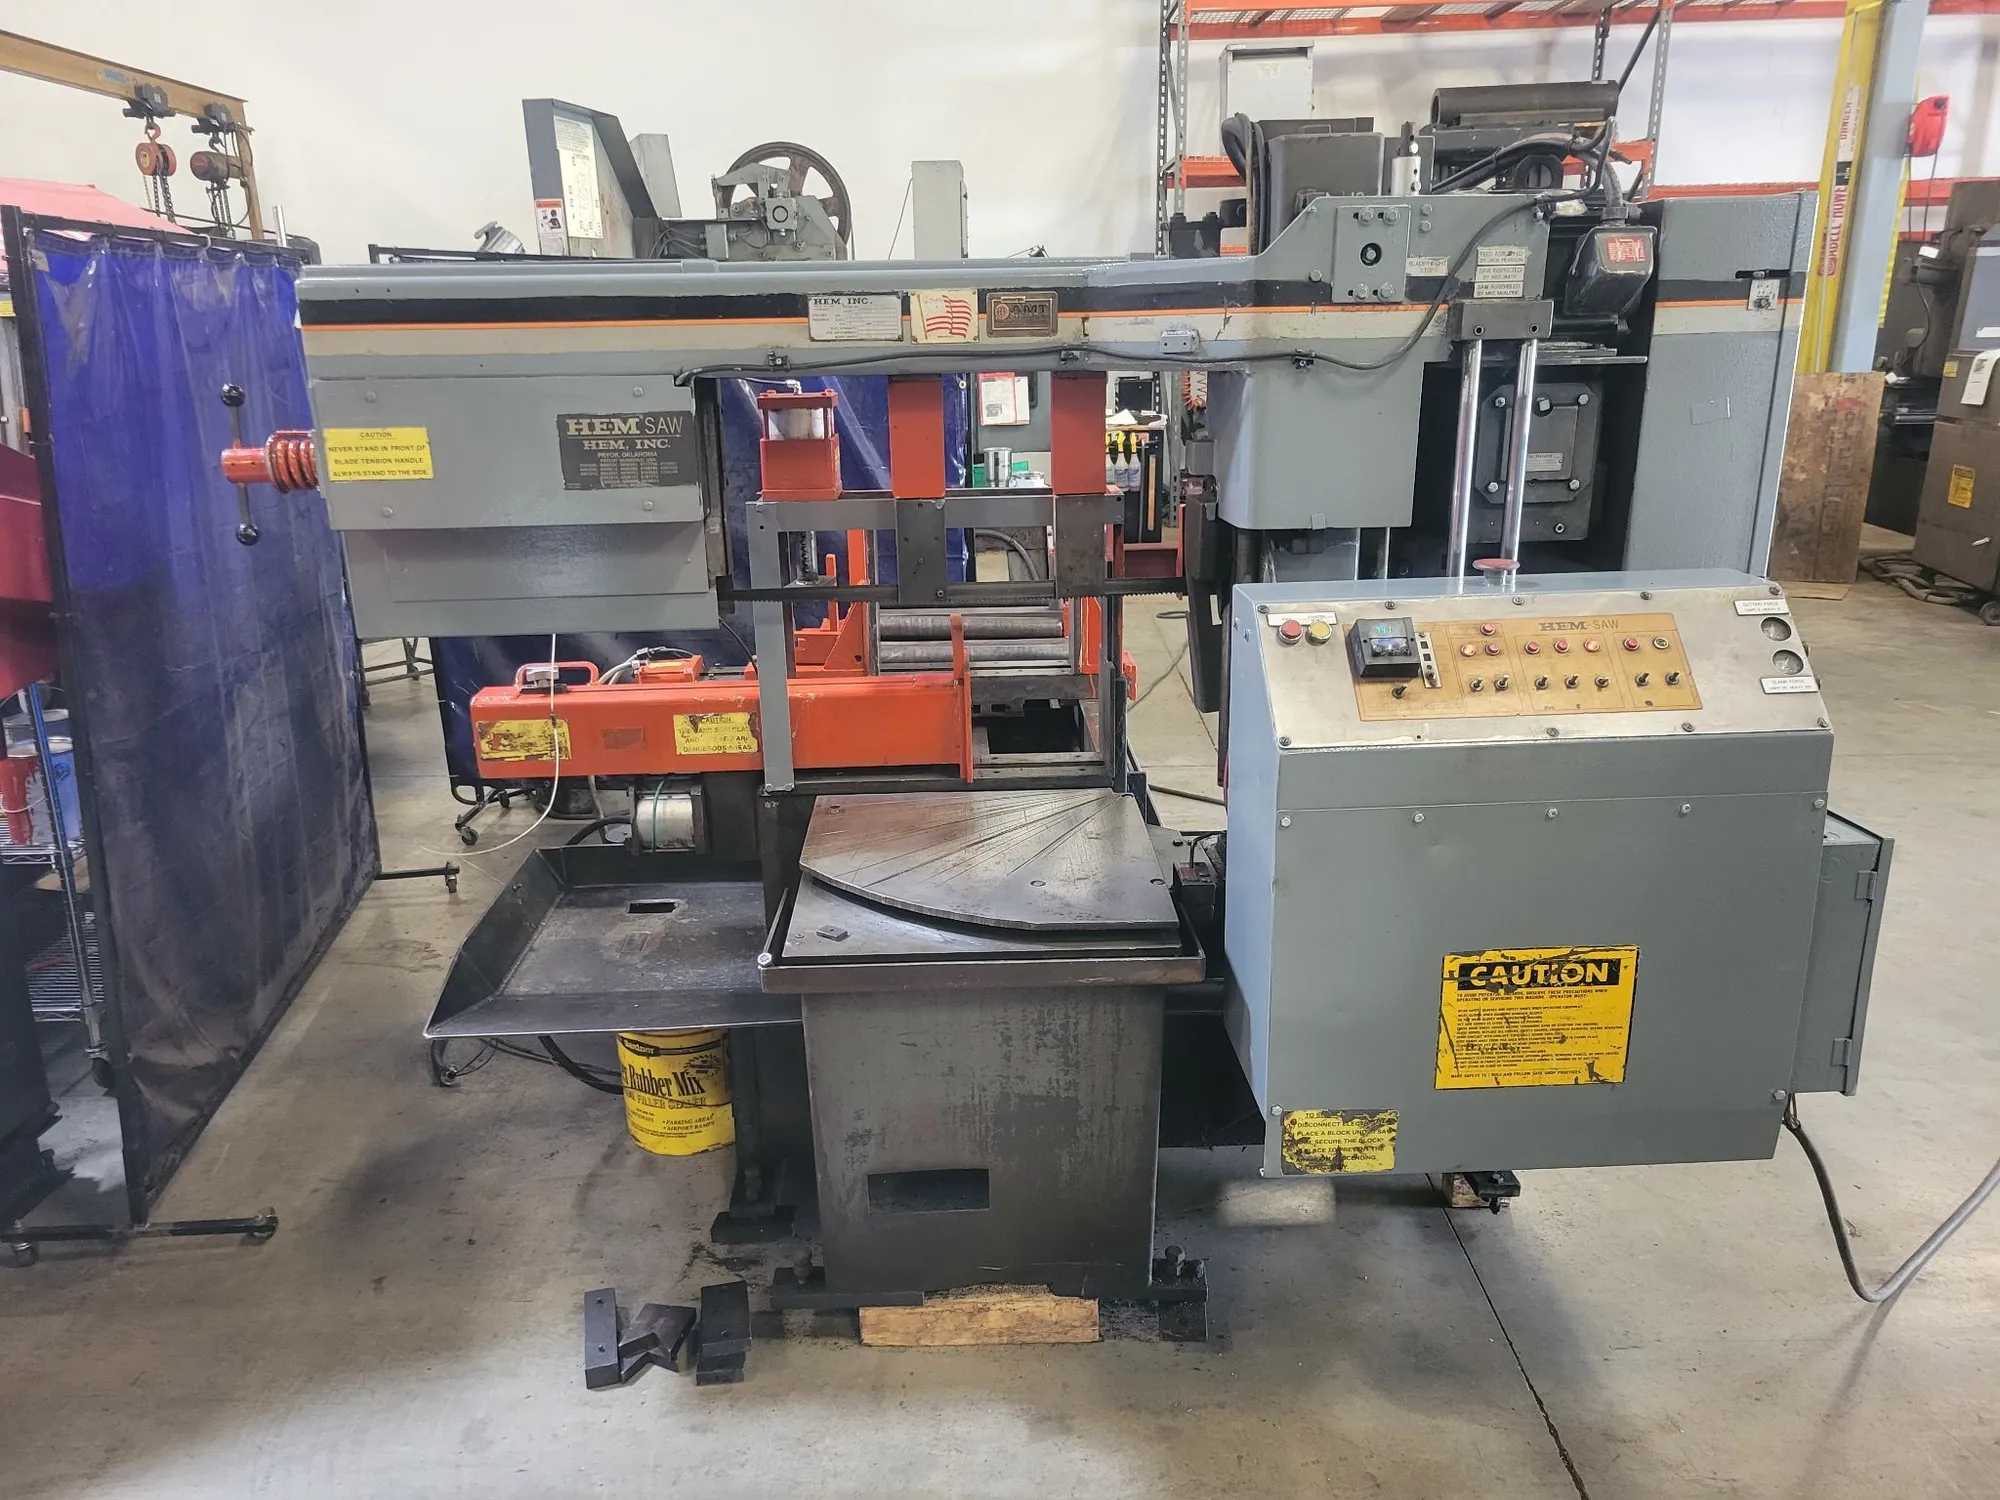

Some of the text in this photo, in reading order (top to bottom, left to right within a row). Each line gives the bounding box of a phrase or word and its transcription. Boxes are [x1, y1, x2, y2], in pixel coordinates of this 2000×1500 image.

[359, 431, 393, 439] CAUTION
[566, 415, 684, 436] HEM SAW
[635, 439, 672, 449] INC.
[1470, 964, 1608, 986] CAUTION
[629, 1064, 673, 1098] Rubber
[672, 1071, 706, 1097] Mix
